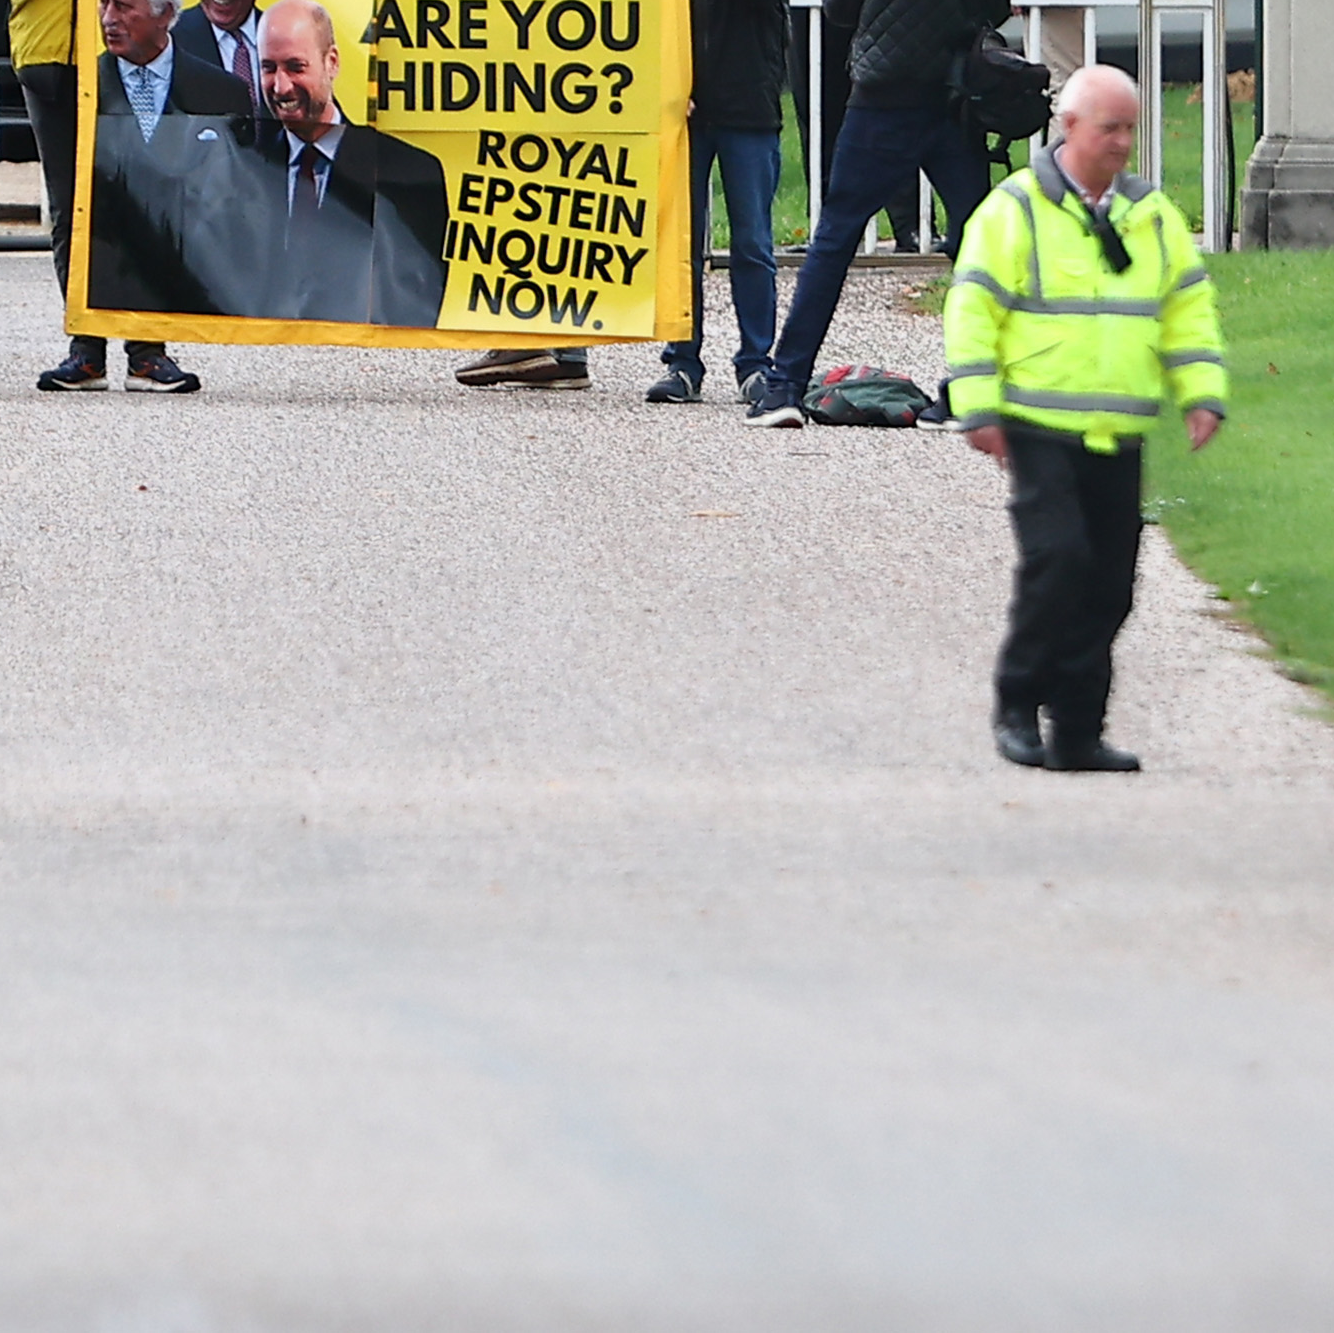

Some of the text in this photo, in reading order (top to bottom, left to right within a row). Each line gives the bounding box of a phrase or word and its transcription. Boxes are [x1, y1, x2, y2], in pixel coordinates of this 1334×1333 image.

[372, 61, 634, 115] HIDING?
[476, 130, 638, 188] ROYAL
[456, 173, 647, 238] EPSTEIN
[443, 220, 649, 286] INQUIRY
[467, 272, 604, 330] NOW.
